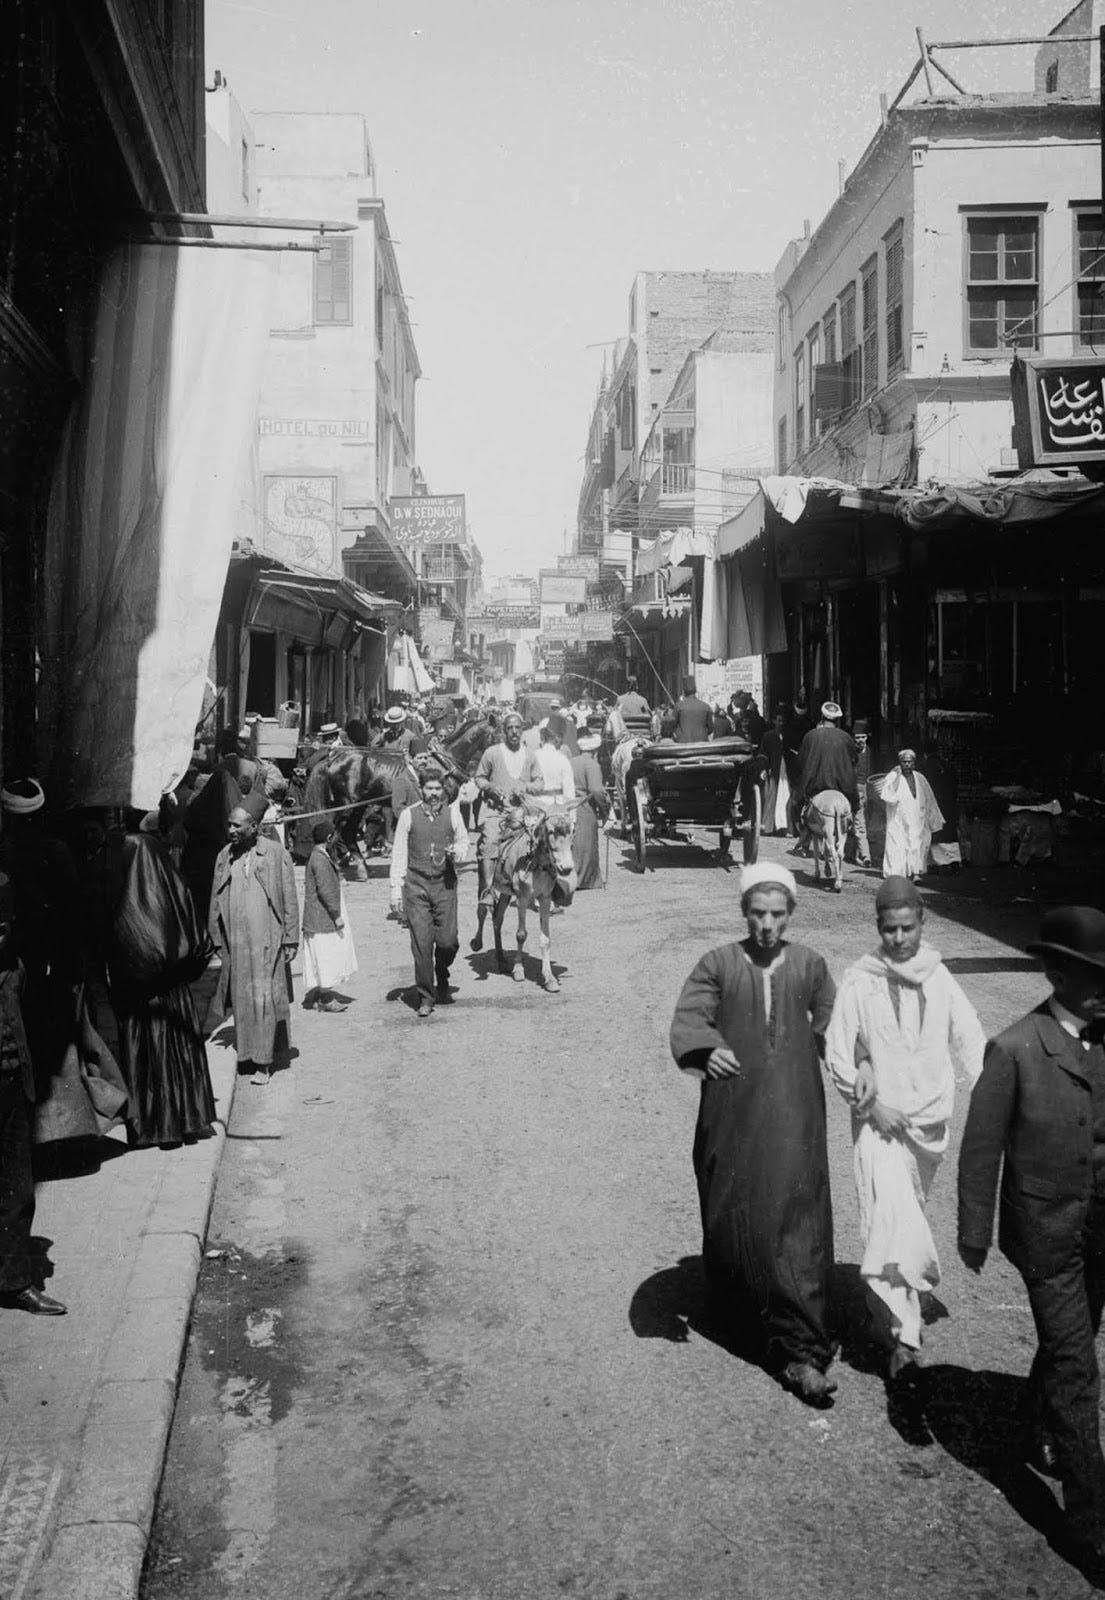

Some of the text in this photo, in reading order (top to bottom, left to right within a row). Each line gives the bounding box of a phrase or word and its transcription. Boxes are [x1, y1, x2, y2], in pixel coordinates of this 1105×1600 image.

[262, 420, 312, 435] HOTEL
[342, 422, 366, 437] NIL
[414, 505, 462, 518] SEDNAOUI
